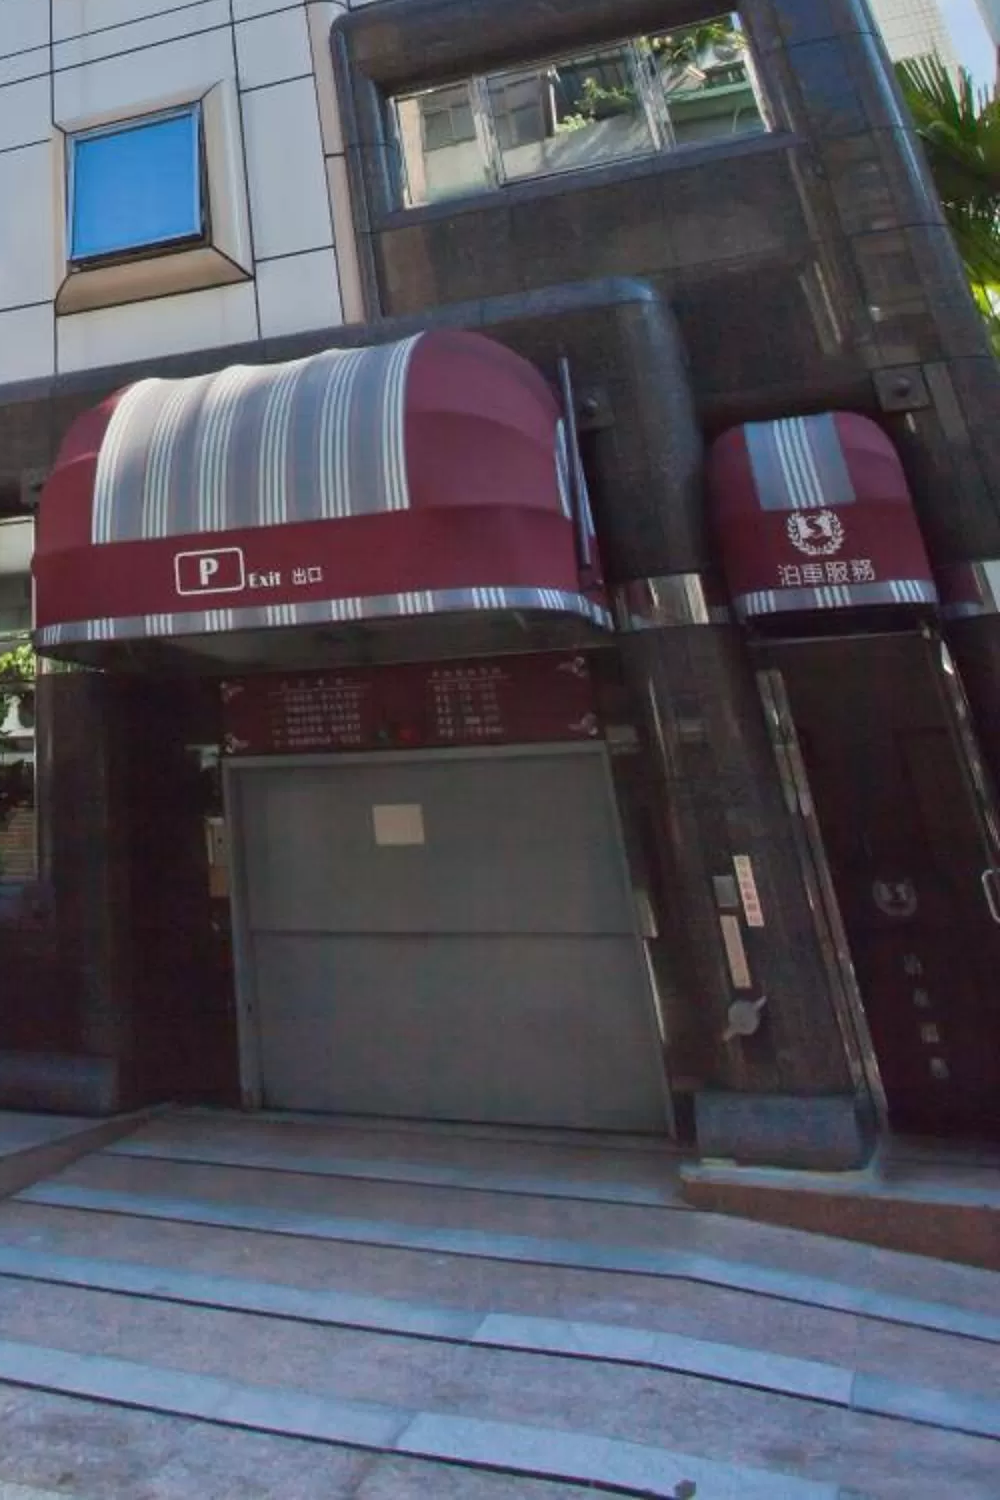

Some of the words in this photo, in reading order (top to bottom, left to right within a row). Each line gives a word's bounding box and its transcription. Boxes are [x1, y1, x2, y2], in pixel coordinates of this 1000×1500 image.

[200, 558, 219, 586] P
[250, 572, 282, 588] Exit
[292, 566, 323, 586] 出口
[777, 559, 875, 587] 泊車服務
